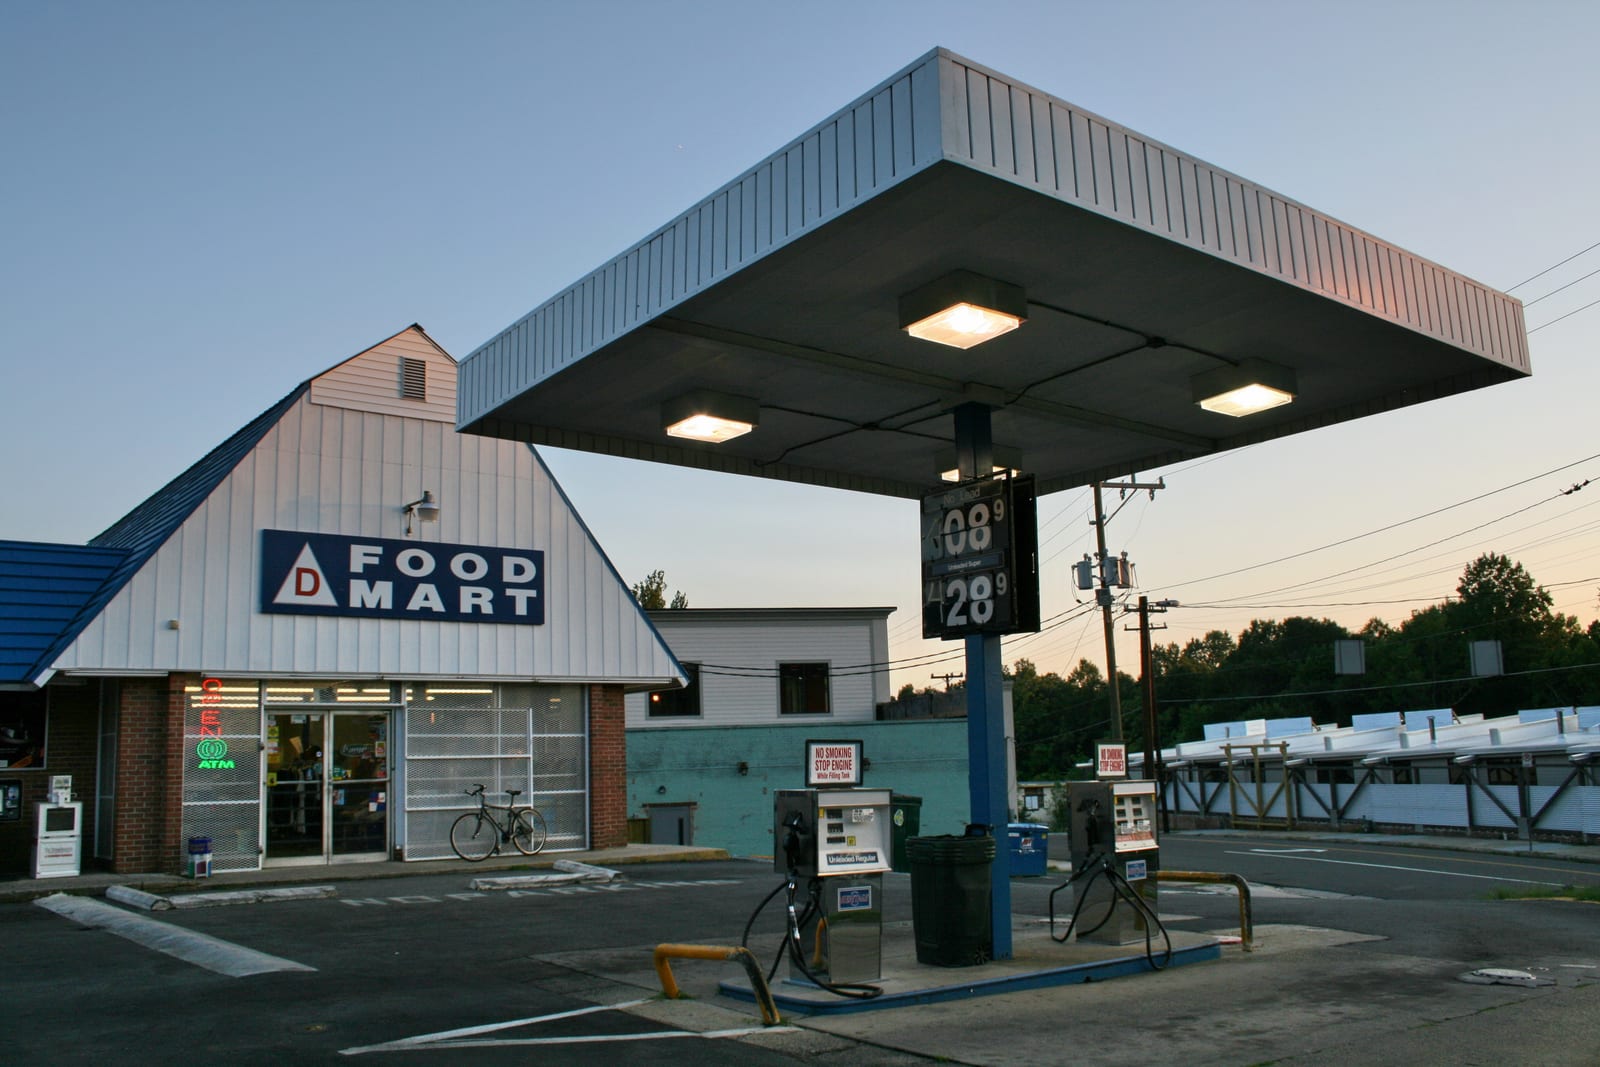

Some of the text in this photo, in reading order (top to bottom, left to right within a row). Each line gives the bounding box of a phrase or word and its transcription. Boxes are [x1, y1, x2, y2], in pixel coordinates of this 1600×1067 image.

[350, 544, 537, 584] FOOD
[295, 567, 320, 597] D
[350, 579, 537, 616] MART
[200, 678, 222, 740] OPEN
[815, 747, 852, 758] NO SMOKING
[198, 760, 236, 768] ATM
[815, 760, 852, 771] STOP ENGINE
[828, 855, 876, 864] Unleaded Regular
